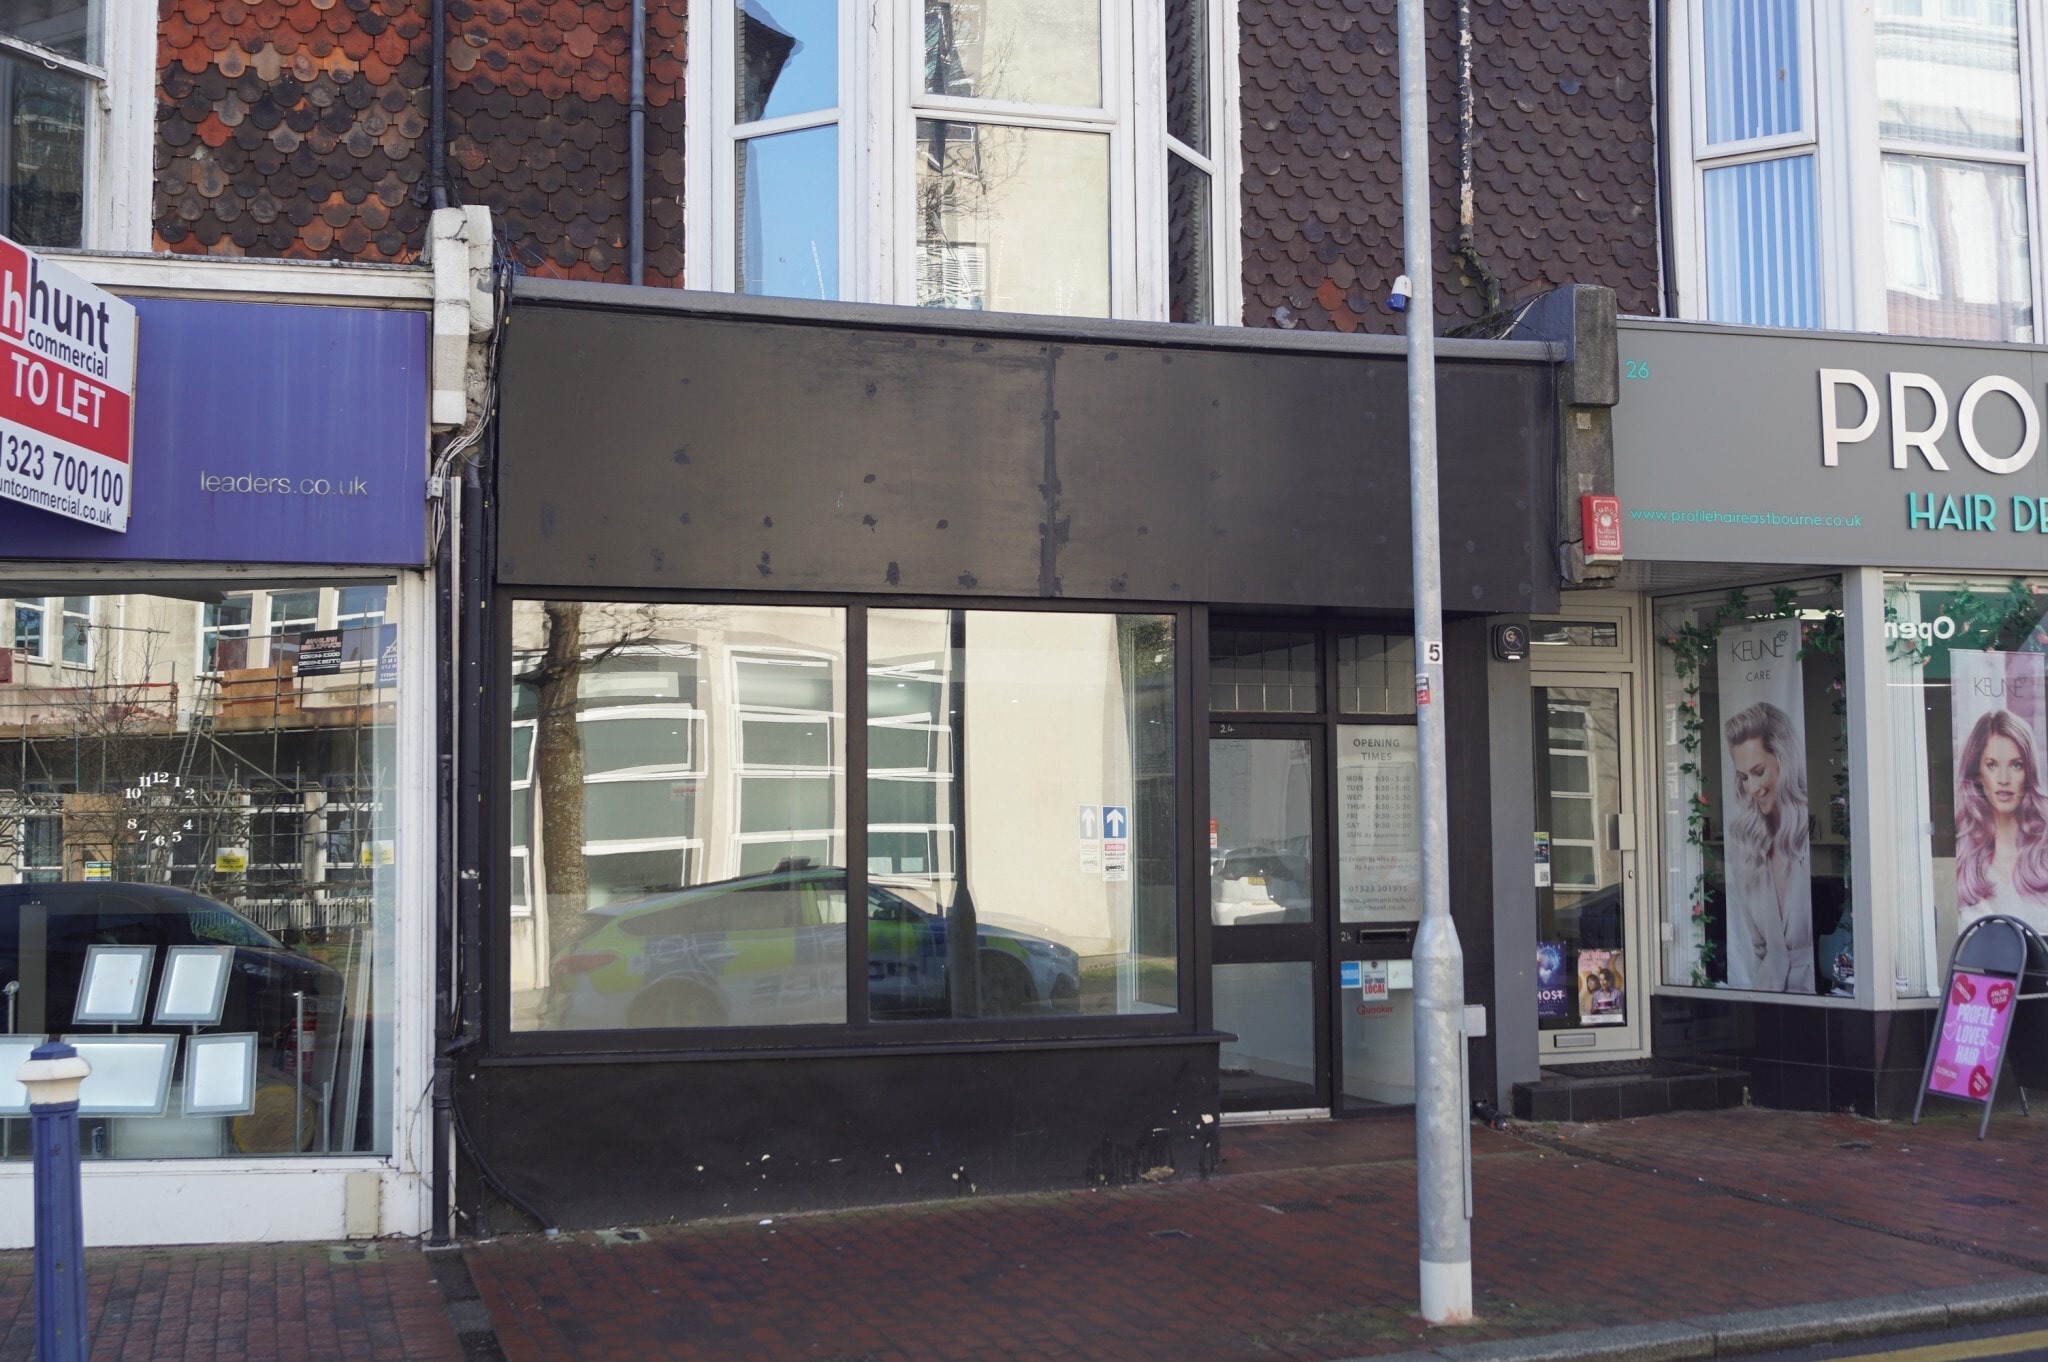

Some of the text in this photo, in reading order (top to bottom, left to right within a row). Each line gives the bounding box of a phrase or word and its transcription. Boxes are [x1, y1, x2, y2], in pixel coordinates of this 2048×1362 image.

[29, 257, 109, 354] hunt
[28, 328, 108, 379] commercial
[1625, 360, 1650, 379] 26
[11, 352, 105, 428] TO LET
[1819, 368, 2040, 475] PRO
[53, 451, 123, 507] 700100
[200, 470, 369, 496] leaders.co.uk
[1630, 509, 1862, 527] www.profilehaireastbourne.co.uk
[1908, 491, 2048, 534] HAIR DE
[1429, 644, 1440, 661] 5
[1731, 636, 1784, 662] KEUNE
[1746, 670, 1771, 681] CARE
[1974, 677, 2024, 698] KEUNE
[1219, 724, 1235, 734] 24
[1353, 738, 1400, 748] OPENING
[1361, 752, 1392, 761] TIMES
[139, 772, 180, 787] 11 12 1
[125, 788, 195, 798] 10 2
[127, 818, 193, 829] 8 4
[139, 830, 182, 846] 7 6 5
[1364, 984, 1385, 994] LOCAL
[1991, 988, 2009, 998] AMAZING
[1956, 1003, 1998, 1026] PROFILE
[1955, 1024, 1989, 1046] LOVES
[1955, 1044, 1980, 1067] HAIR
